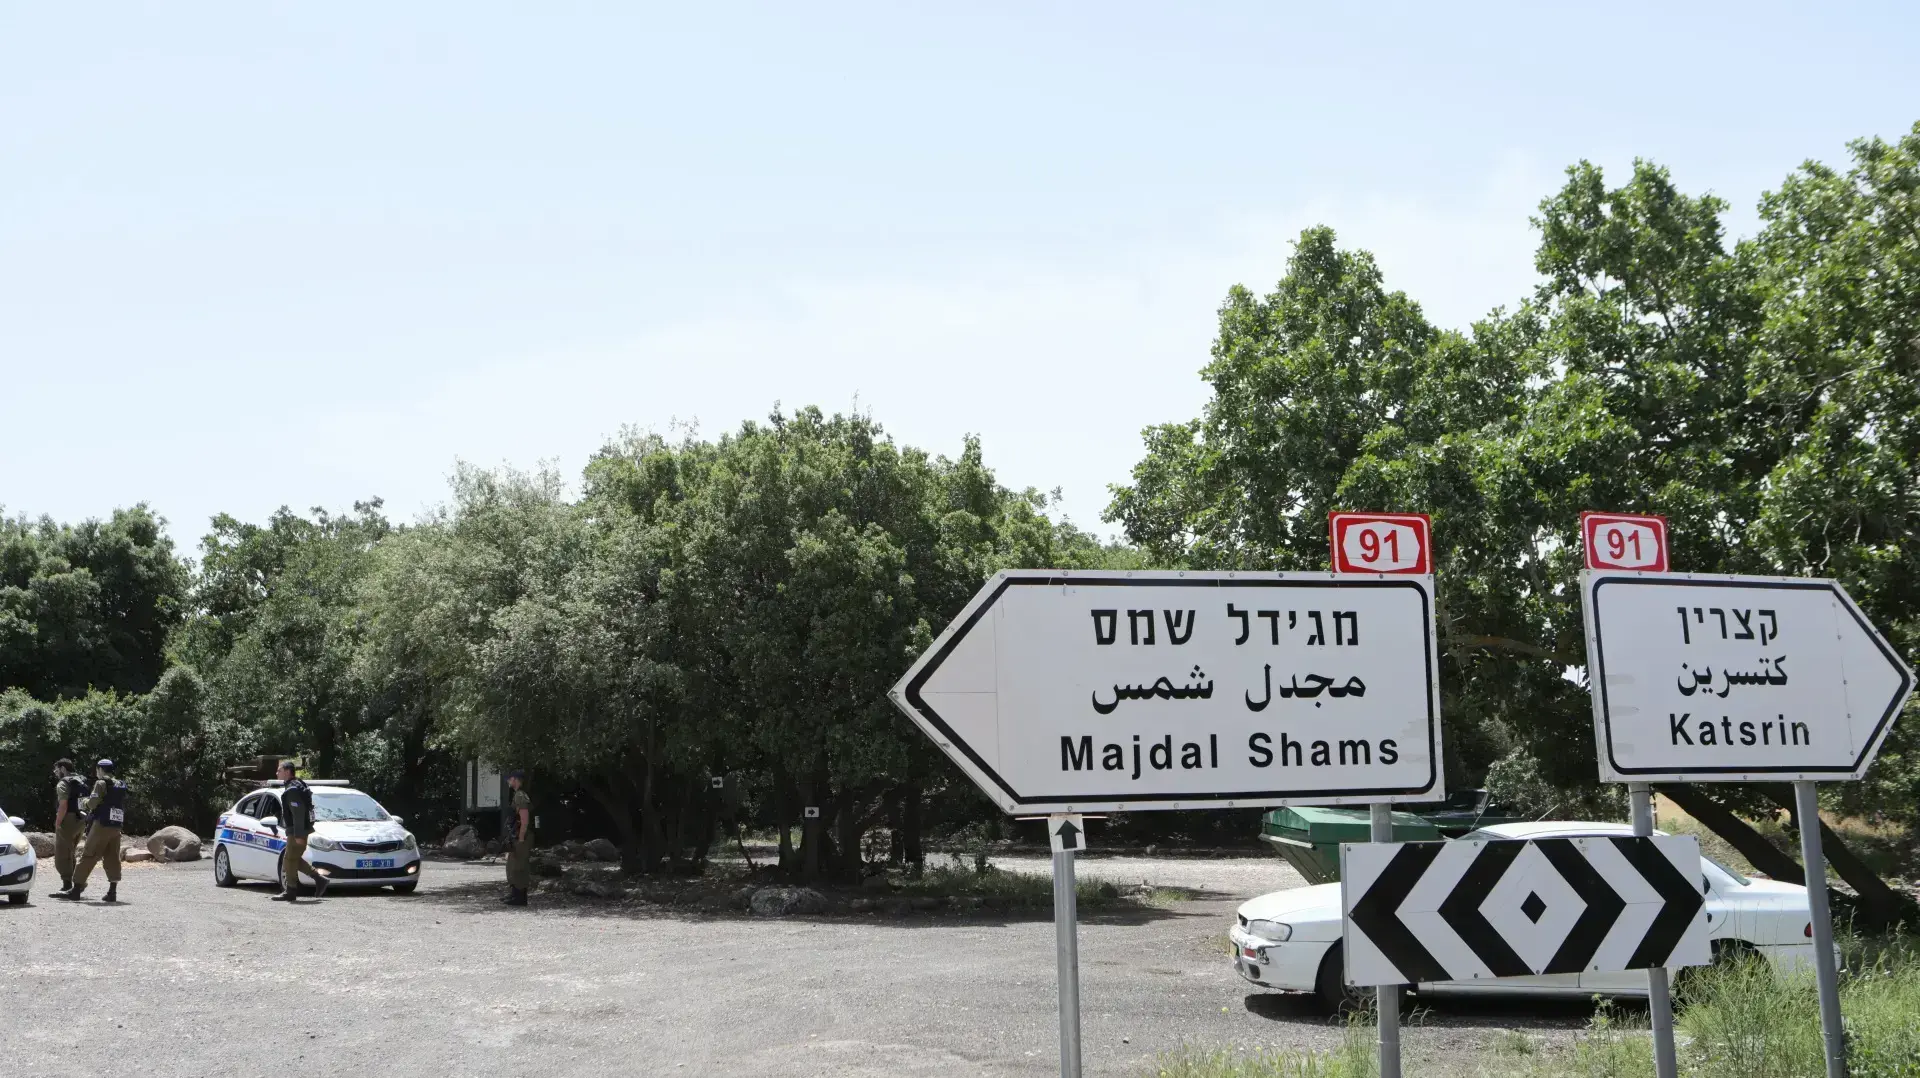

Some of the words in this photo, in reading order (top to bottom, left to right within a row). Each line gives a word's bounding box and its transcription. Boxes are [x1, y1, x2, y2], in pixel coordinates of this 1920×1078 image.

[1359, 528, 1399, 563] 91
[1606, 528, 1641, 561] 91
[1090, 609, 1196, 646] שמס
[1676, 606, 1778, 647] קצרין
[1091, 664, 1214, 715] شمس
[1244, 663, 1367, 713] مجدل
[1677, 654, 1789, 699] كتسرين
[1669, 713, 1810, 746] Katsrin
[1060, 734, 1219, 781] Majdal
[1248, 732, 1399, 768] Shams
